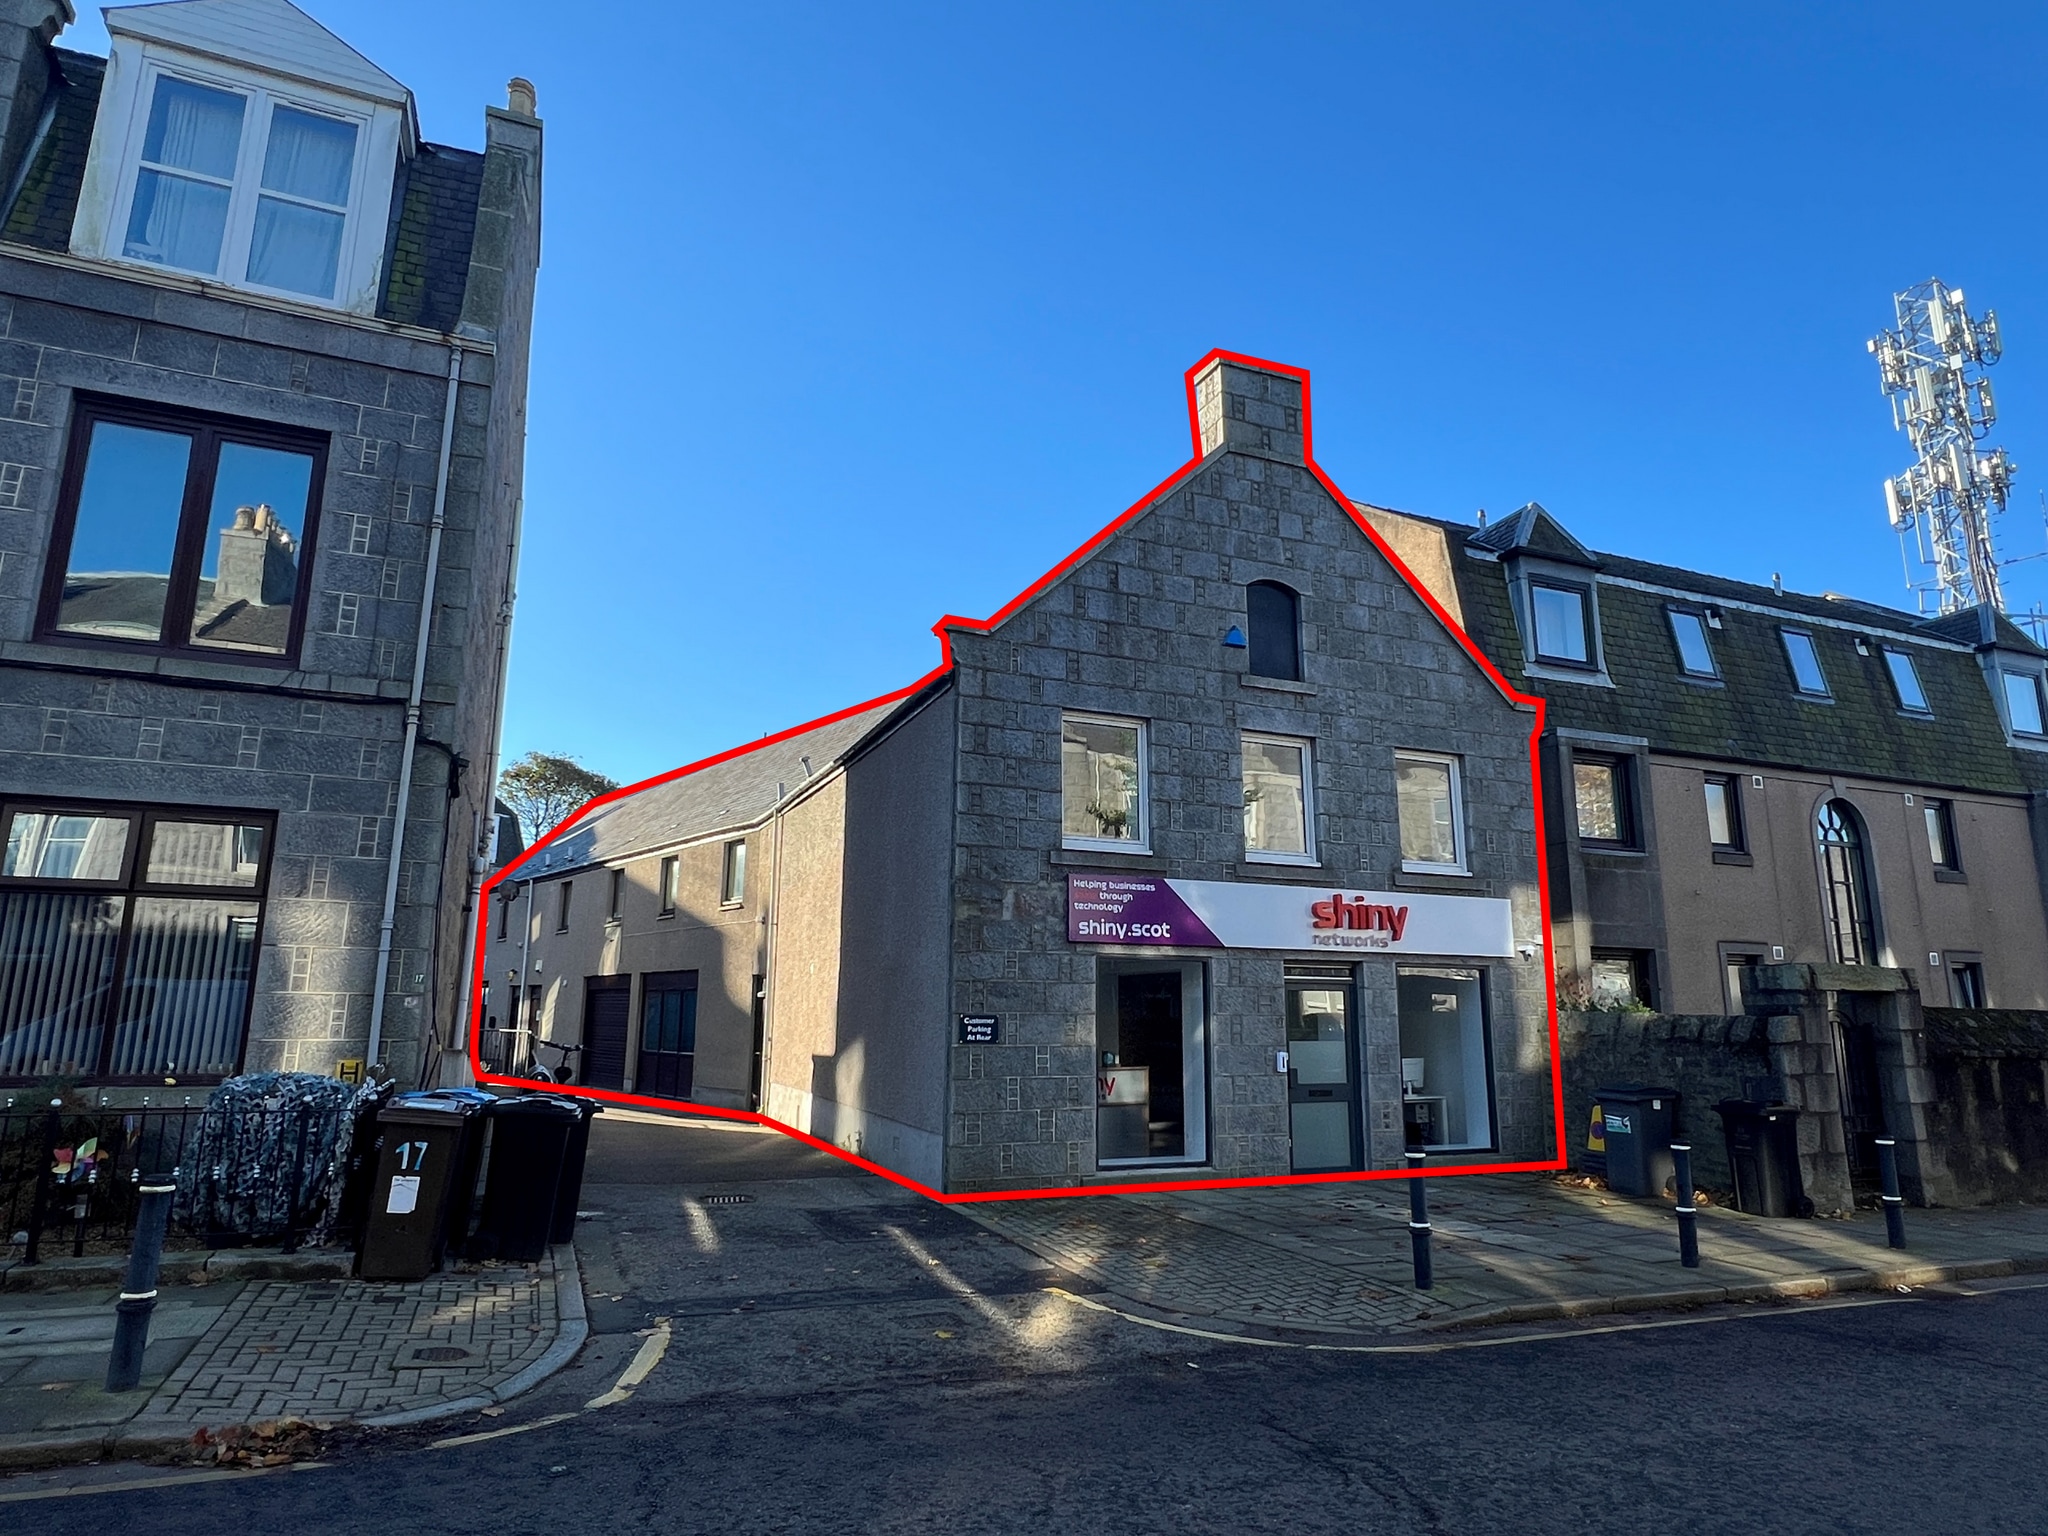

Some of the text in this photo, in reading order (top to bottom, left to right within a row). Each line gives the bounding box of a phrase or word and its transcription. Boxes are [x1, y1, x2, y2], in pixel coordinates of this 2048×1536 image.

[1073, 879, 1156, 892] Helping businesses
[1099, 892, 1134, 903] through
[1073, 902, 1124, 914] technology
[1311, 893, 1409, 942] shiny
[1078, 918, 1171, 940] shiny.scot
[1312, 933, 1389, 949] networks
[414, 974, 425, 983] 17
[967, 1025, 992, 1034] Parking
[395, 1141, 429, 1171] 17
